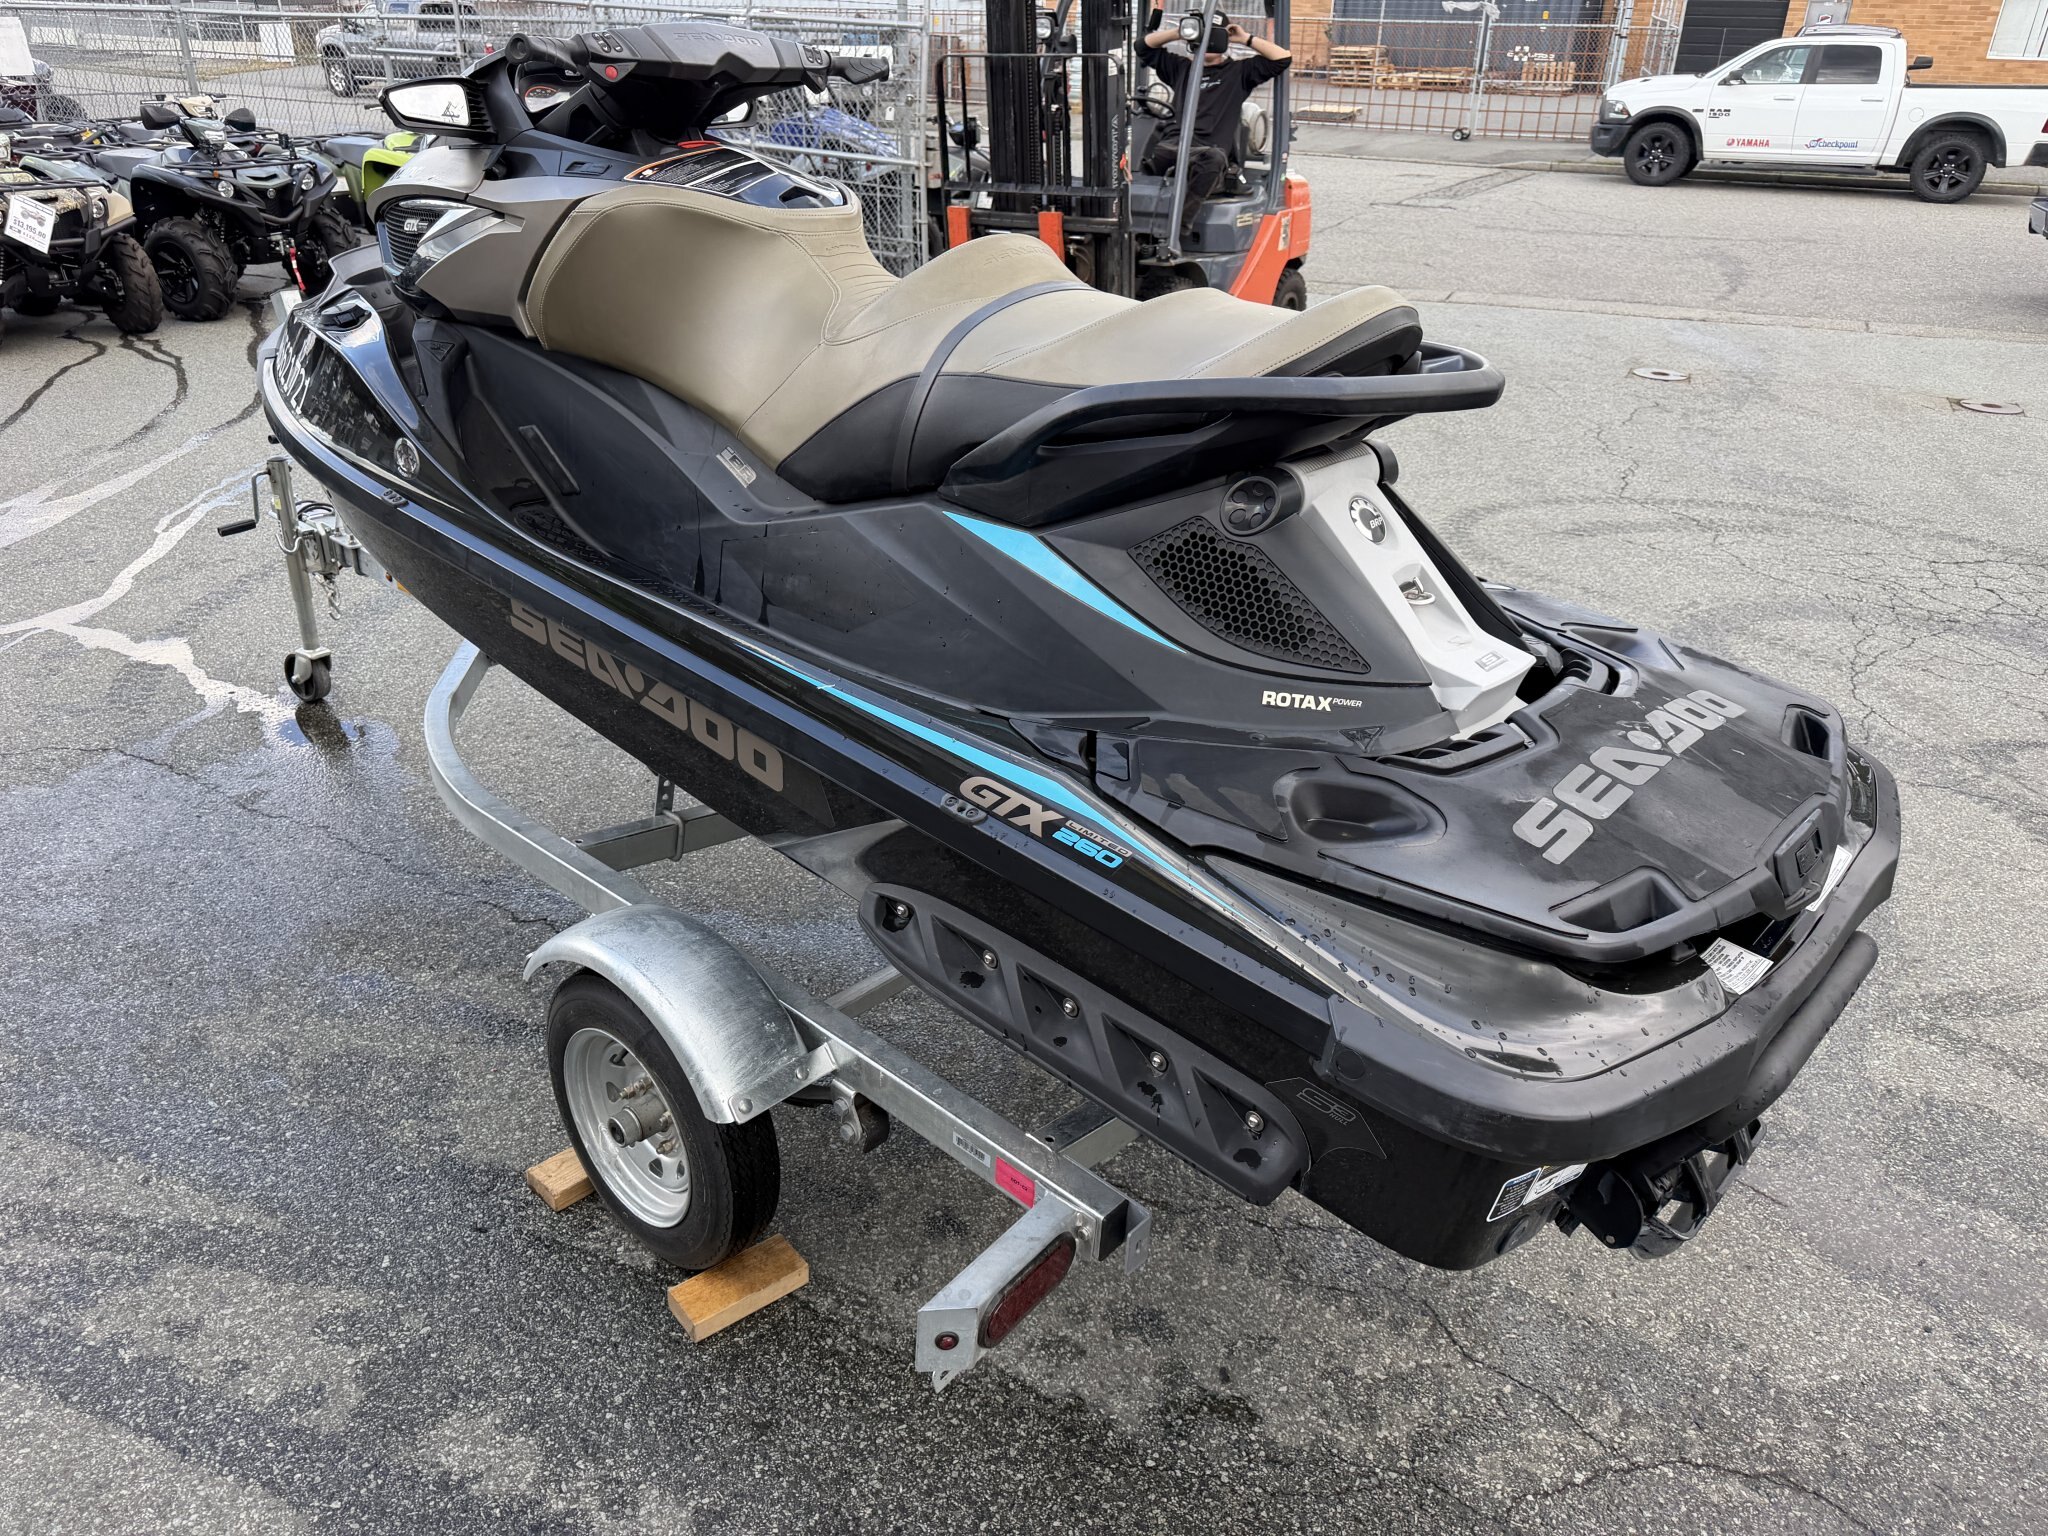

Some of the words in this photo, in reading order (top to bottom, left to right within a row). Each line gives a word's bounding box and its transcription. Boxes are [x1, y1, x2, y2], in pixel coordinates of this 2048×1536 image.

[1736, 139, 1770, 148] YAMAHA
[1818, 138, 1859, 151] checkpoint
[1370, 516, 1383, 529] BRP
[1261, 690, 1332, 712] ROTAX
[1332, 697, 1363, 708] POWER
[959, 776, 1066, 839] GTX
[1066, 820, 1132, 858] LIMITED
[1052, 826, 1124, 869] 260
